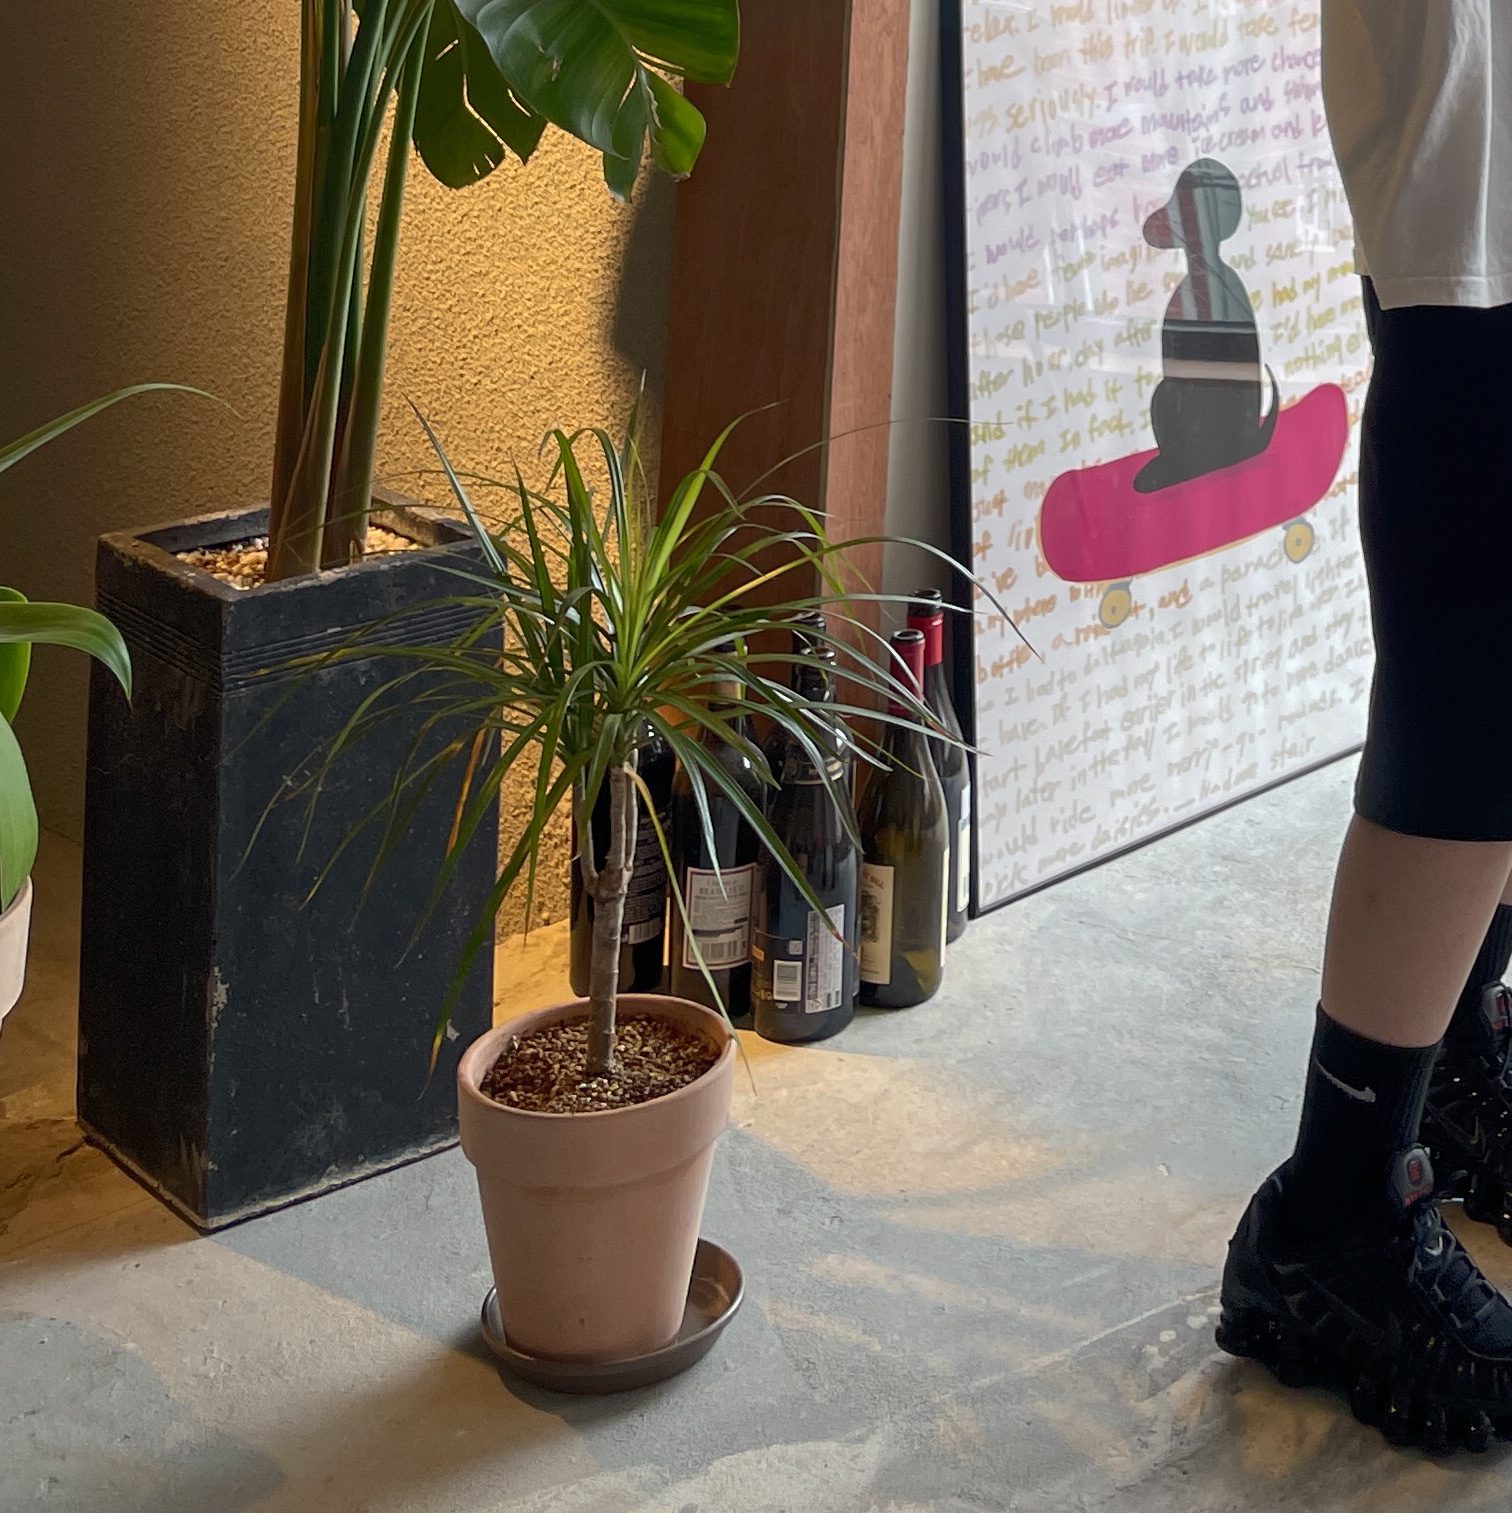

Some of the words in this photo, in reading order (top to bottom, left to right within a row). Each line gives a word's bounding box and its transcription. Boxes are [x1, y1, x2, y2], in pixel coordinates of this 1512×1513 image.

[1103, 80, 1118, 113] I
[1175, 64, 1217, 90] take
[1223, 54, 1266, 86] more
[1240, 86, 1274, 115] and
[1158, 578, 1193, 610] and
